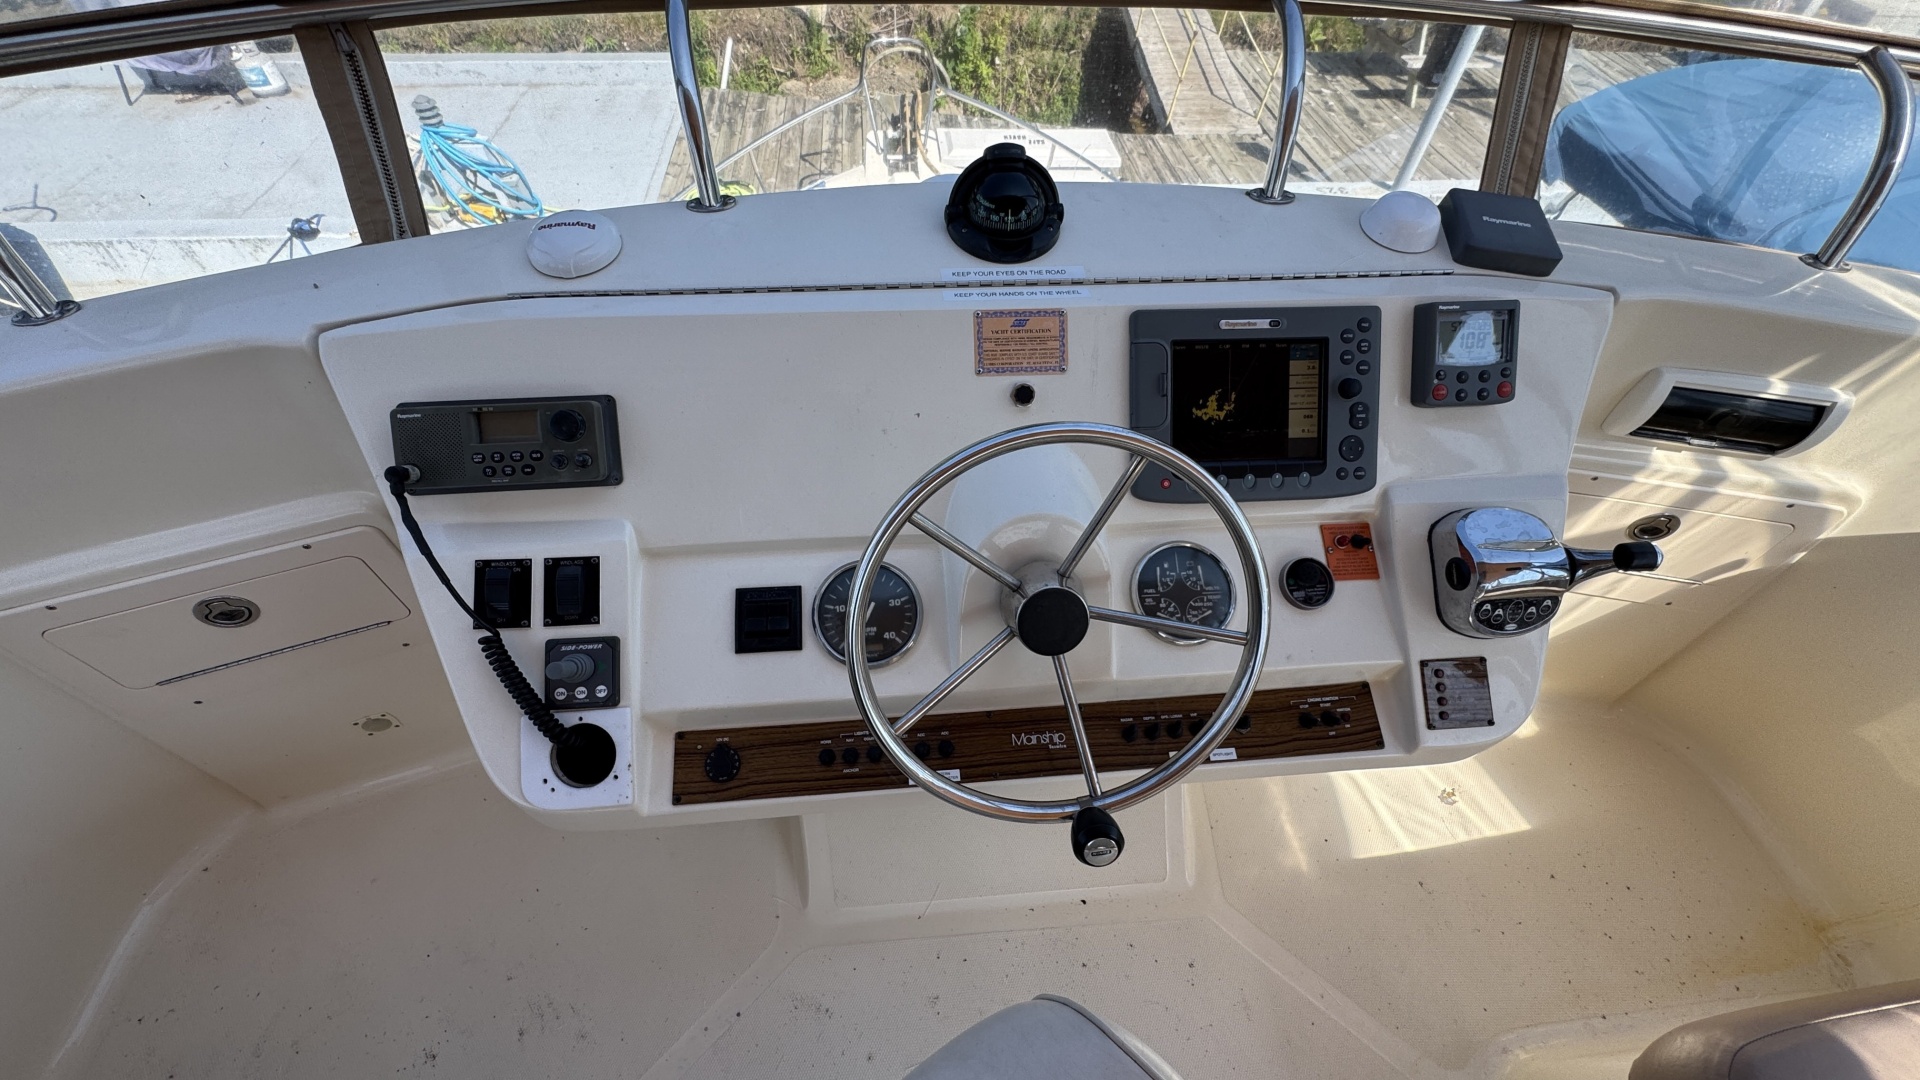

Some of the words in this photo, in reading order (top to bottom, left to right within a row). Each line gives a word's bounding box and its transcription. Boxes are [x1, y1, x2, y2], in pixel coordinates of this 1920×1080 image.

[537, 220, 597, 231] Raymarine
[1482, 215, 1532, 228] Raymarine
[883, 631, 896, 639] 40
[560, 643, 603, 652] SIDE-POWER
[1011, 730, 1066, 746] Mainship
